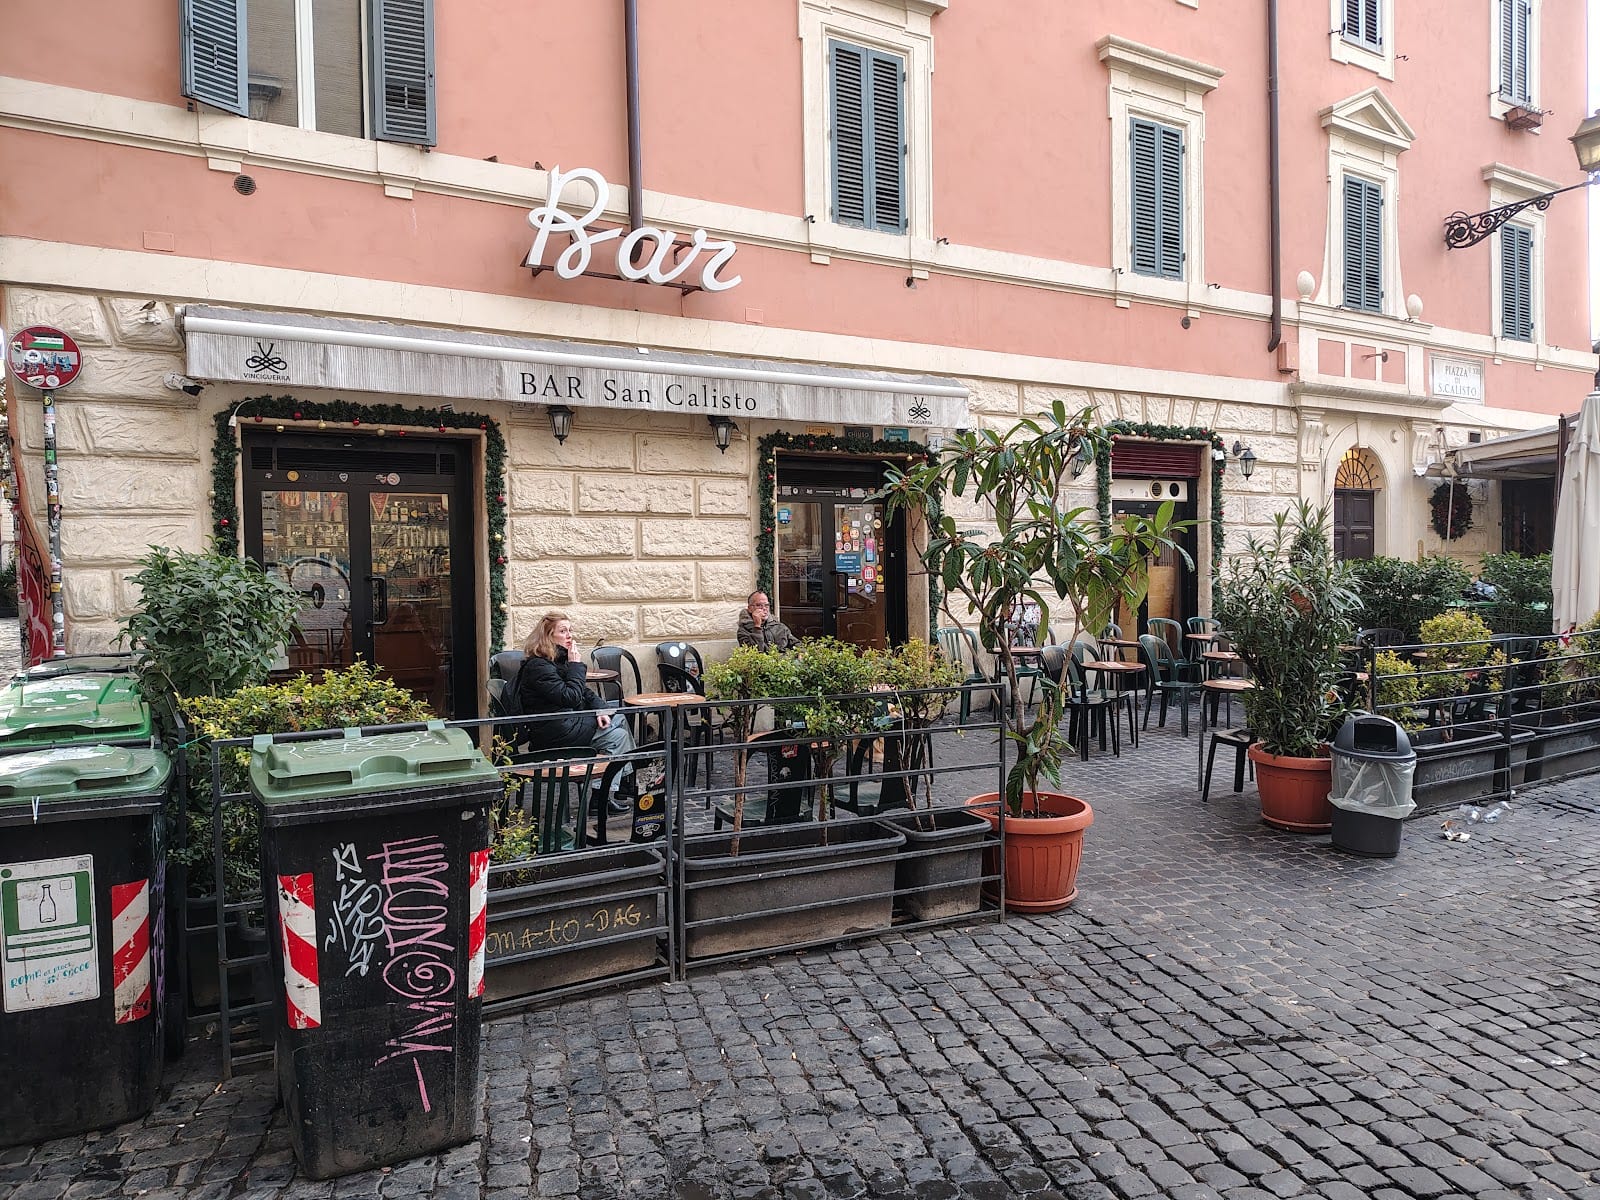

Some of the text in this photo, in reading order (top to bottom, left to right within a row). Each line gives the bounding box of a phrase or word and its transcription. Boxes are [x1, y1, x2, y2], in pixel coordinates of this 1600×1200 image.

[527, 164, 742, 292] Bar
[243, 372, 291, 381] VINCIGUERRA
[1445, 366, 1468, 377] PIAZZA
[519, 372, 757, 411] BAR San Calisto
[1438, 383, 1477, 396] S.CALISTO
